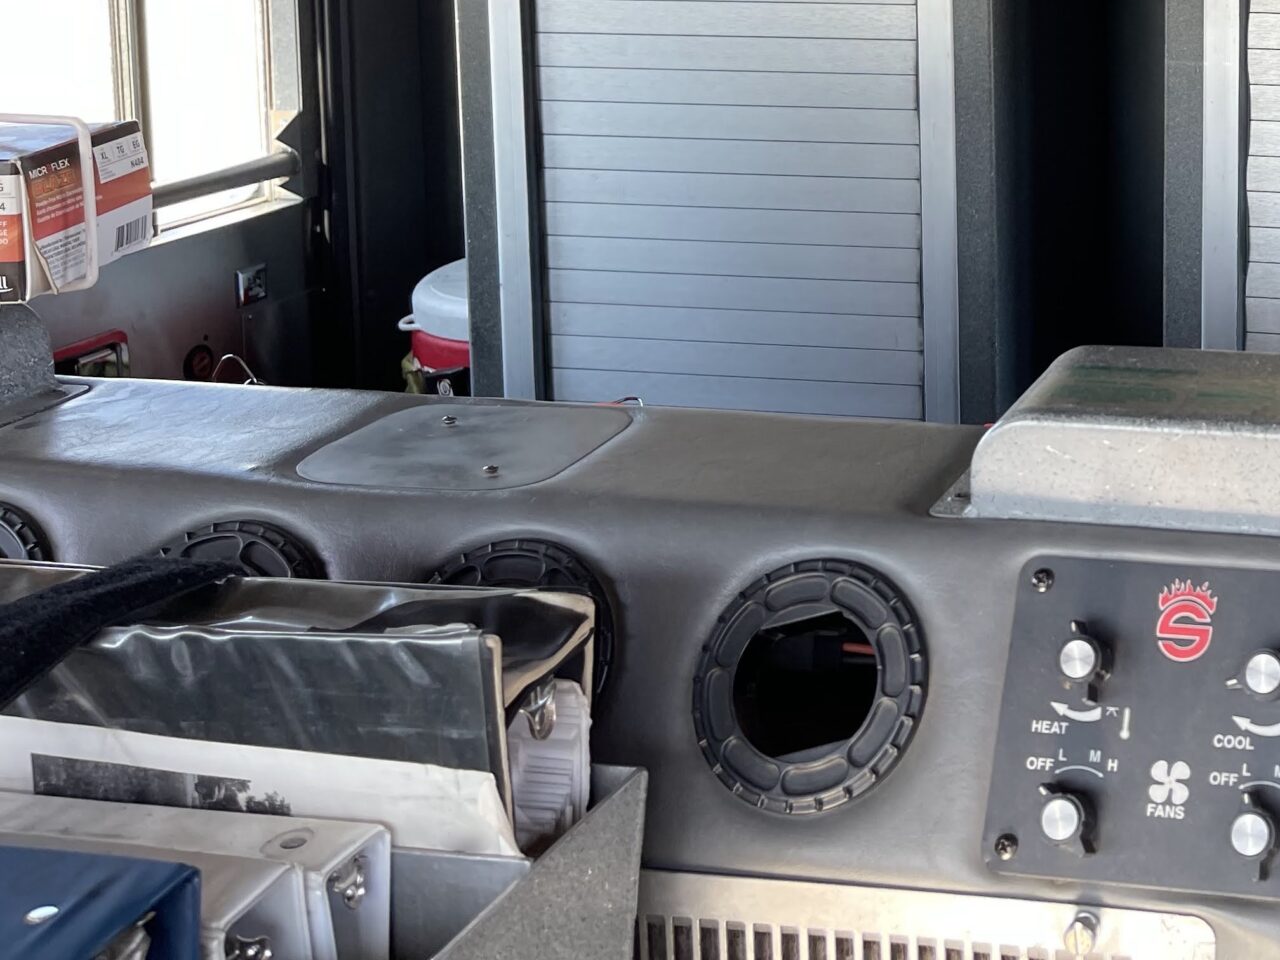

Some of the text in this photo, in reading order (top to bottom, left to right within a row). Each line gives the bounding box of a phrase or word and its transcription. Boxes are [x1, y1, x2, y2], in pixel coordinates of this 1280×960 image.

[1031, 720, 1069, 735] HEAT
[1213, 734, 1254, 750] COOL
[1026, 748, 1118, 772] OFF L M H
[1209, 772, 1238, 786] OFF
[1242, 763, 1251, 776] L
[1146, 803, 1185, 819] FANS
